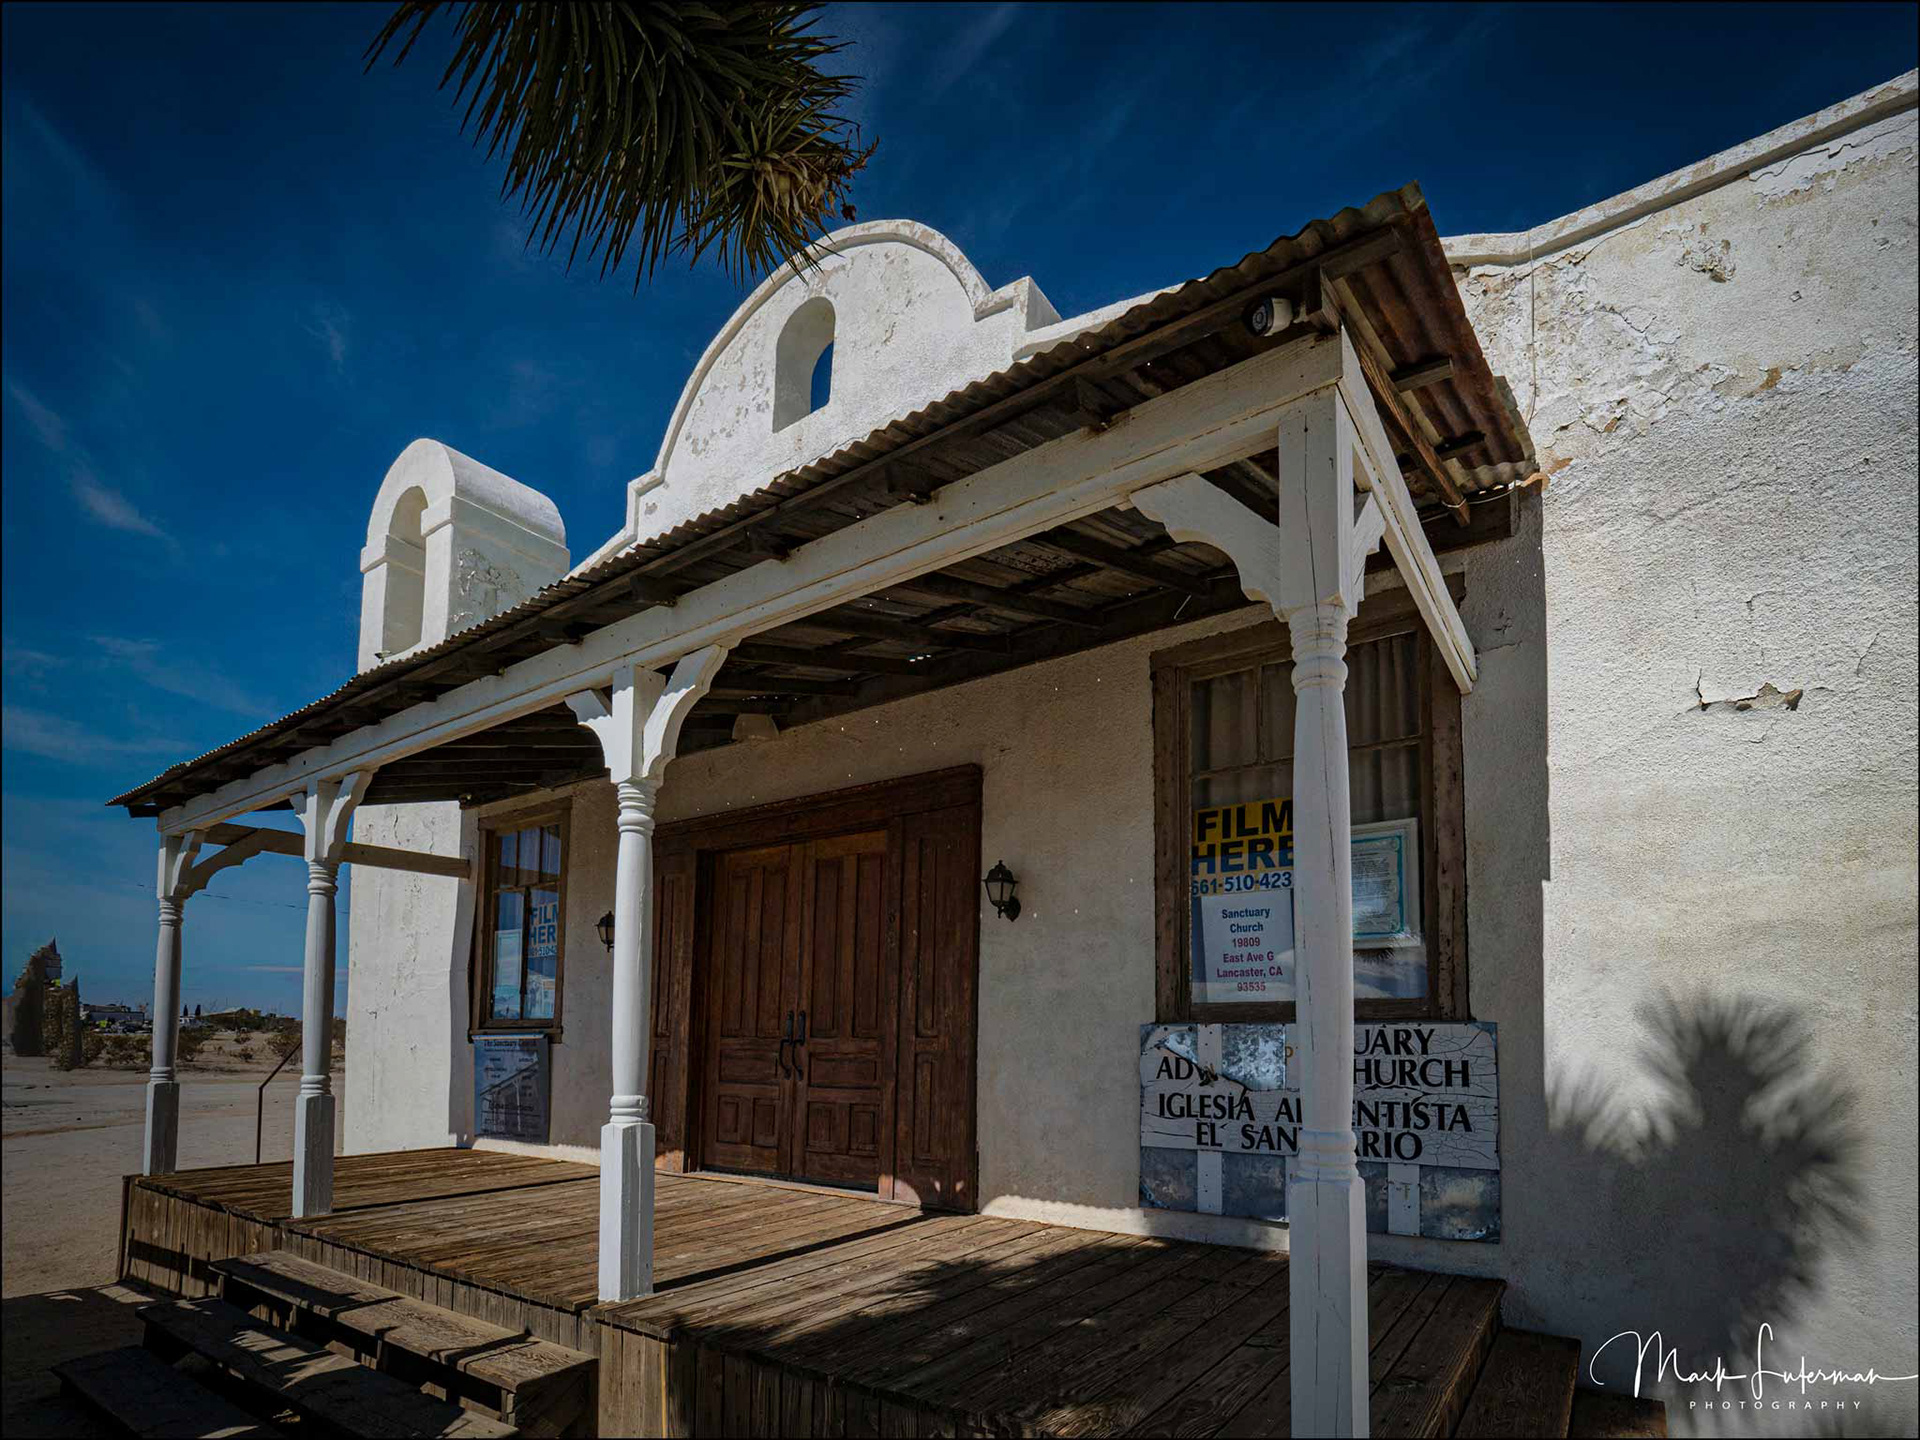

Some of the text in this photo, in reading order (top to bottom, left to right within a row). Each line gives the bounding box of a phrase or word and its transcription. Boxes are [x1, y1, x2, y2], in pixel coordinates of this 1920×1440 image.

[1197, 800, 1294, 842] FILM
[1192, 835, 1294, 876] HERE
[1192, 872, 1292, 896] 661-510-423
[1221, 907, 1271, 919] Sanctuary
[1229, 922, 1264, 933] Church
[1232, 937, 1261, 948] 19809
[1223, 951, 1275, 963] East Ave G
[1216, 966, 1284, 978] Lancaster, CA
[1237, 981, 1266, 992] 93535
[1354, 1028, 1435, 1056] UARY
[1354, 1058, 1470, 1088] HURCH
[1159, 1092, 1256, 1122] IGLESIA
[1196, 1121, 1223, 1148] EL
